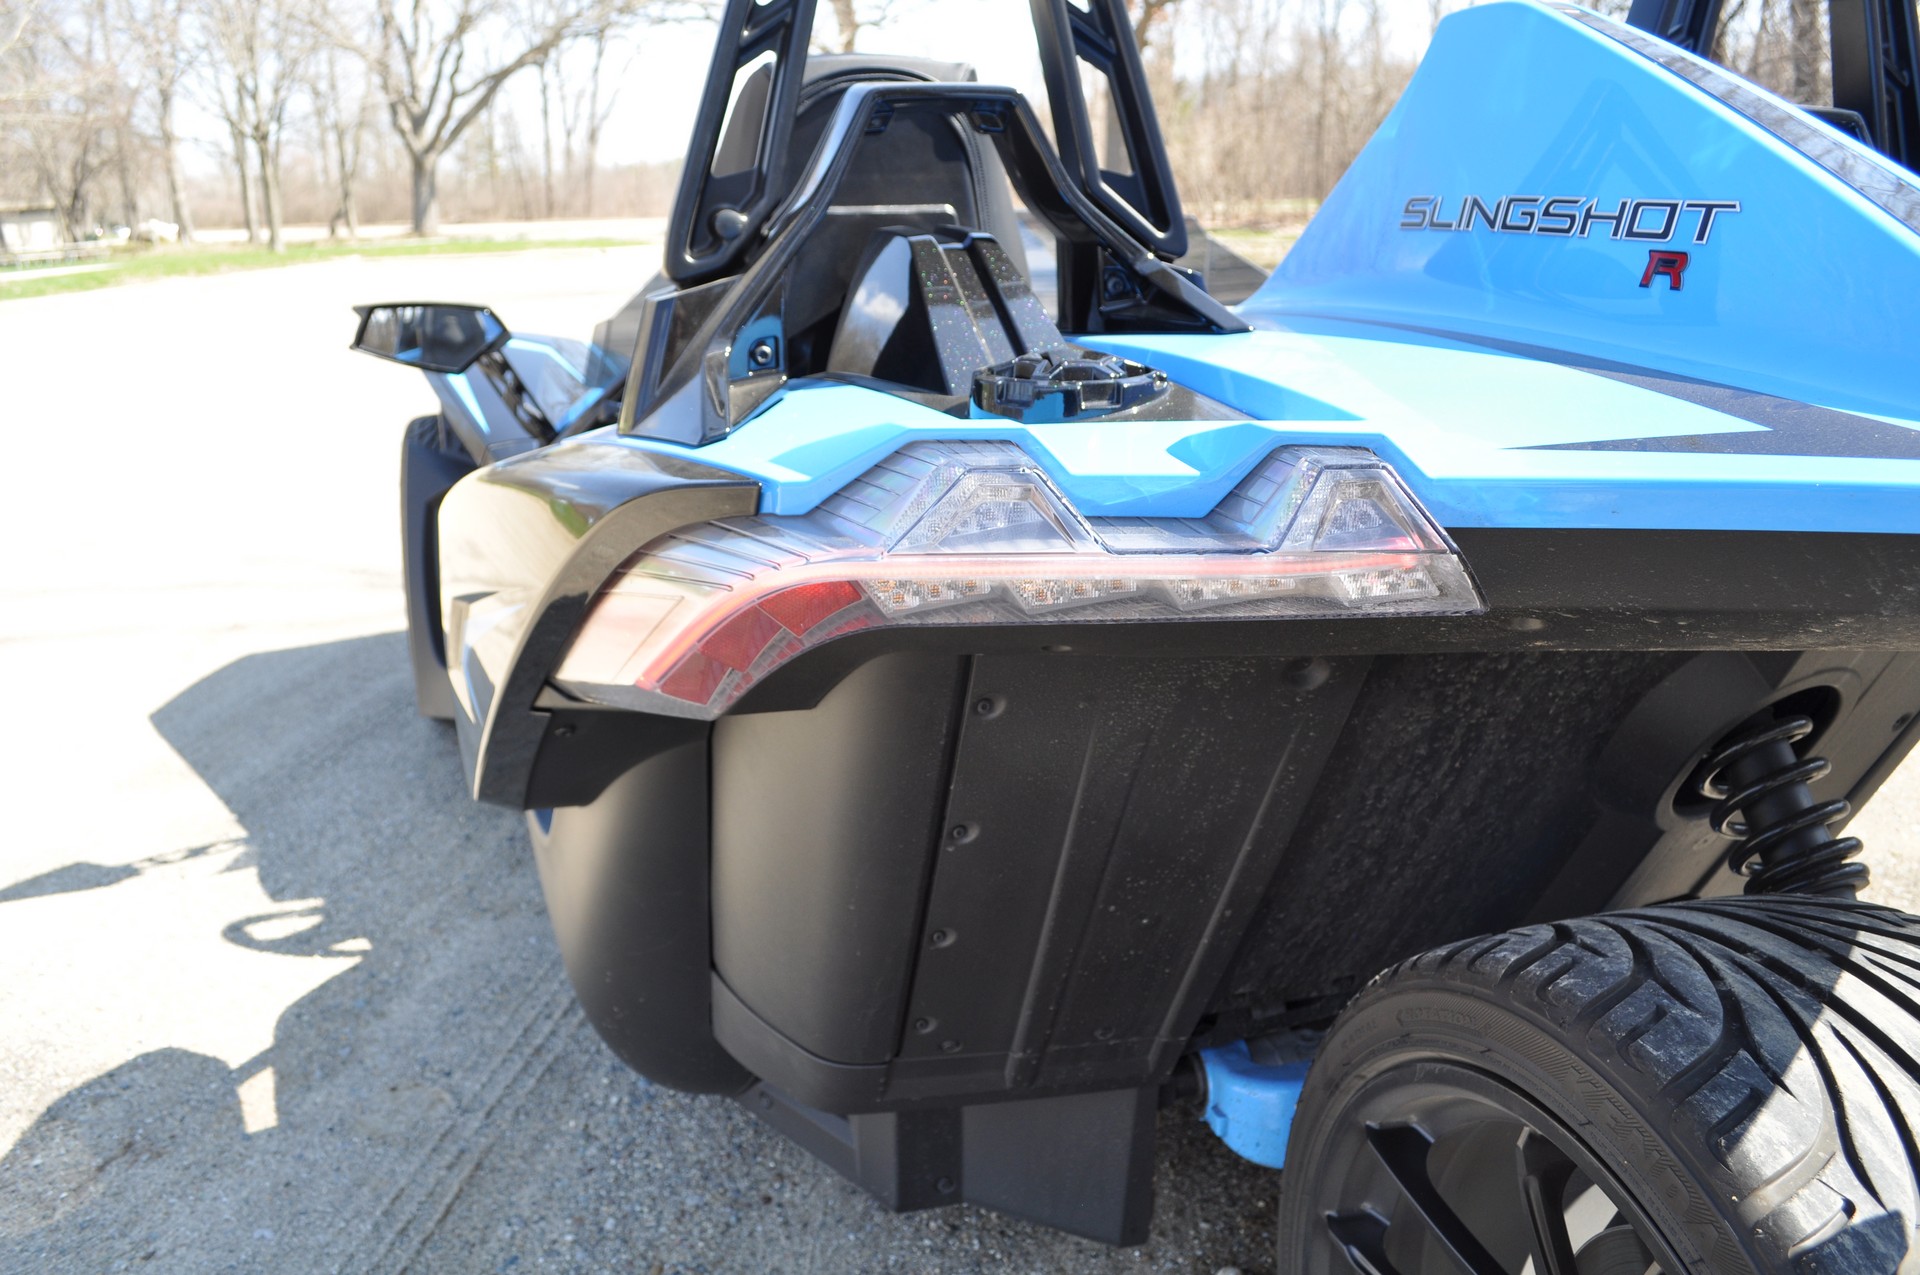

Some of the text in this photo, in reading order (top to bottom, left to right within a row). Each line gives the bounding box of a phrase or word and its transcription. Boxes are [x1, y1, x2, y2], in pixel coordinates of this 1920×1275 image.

[1399, 195, 1742, 245] SLINGSHOT
[1639, 249, 1691, 291] R
[1559, 1064, 1722, 1265] KENDA
